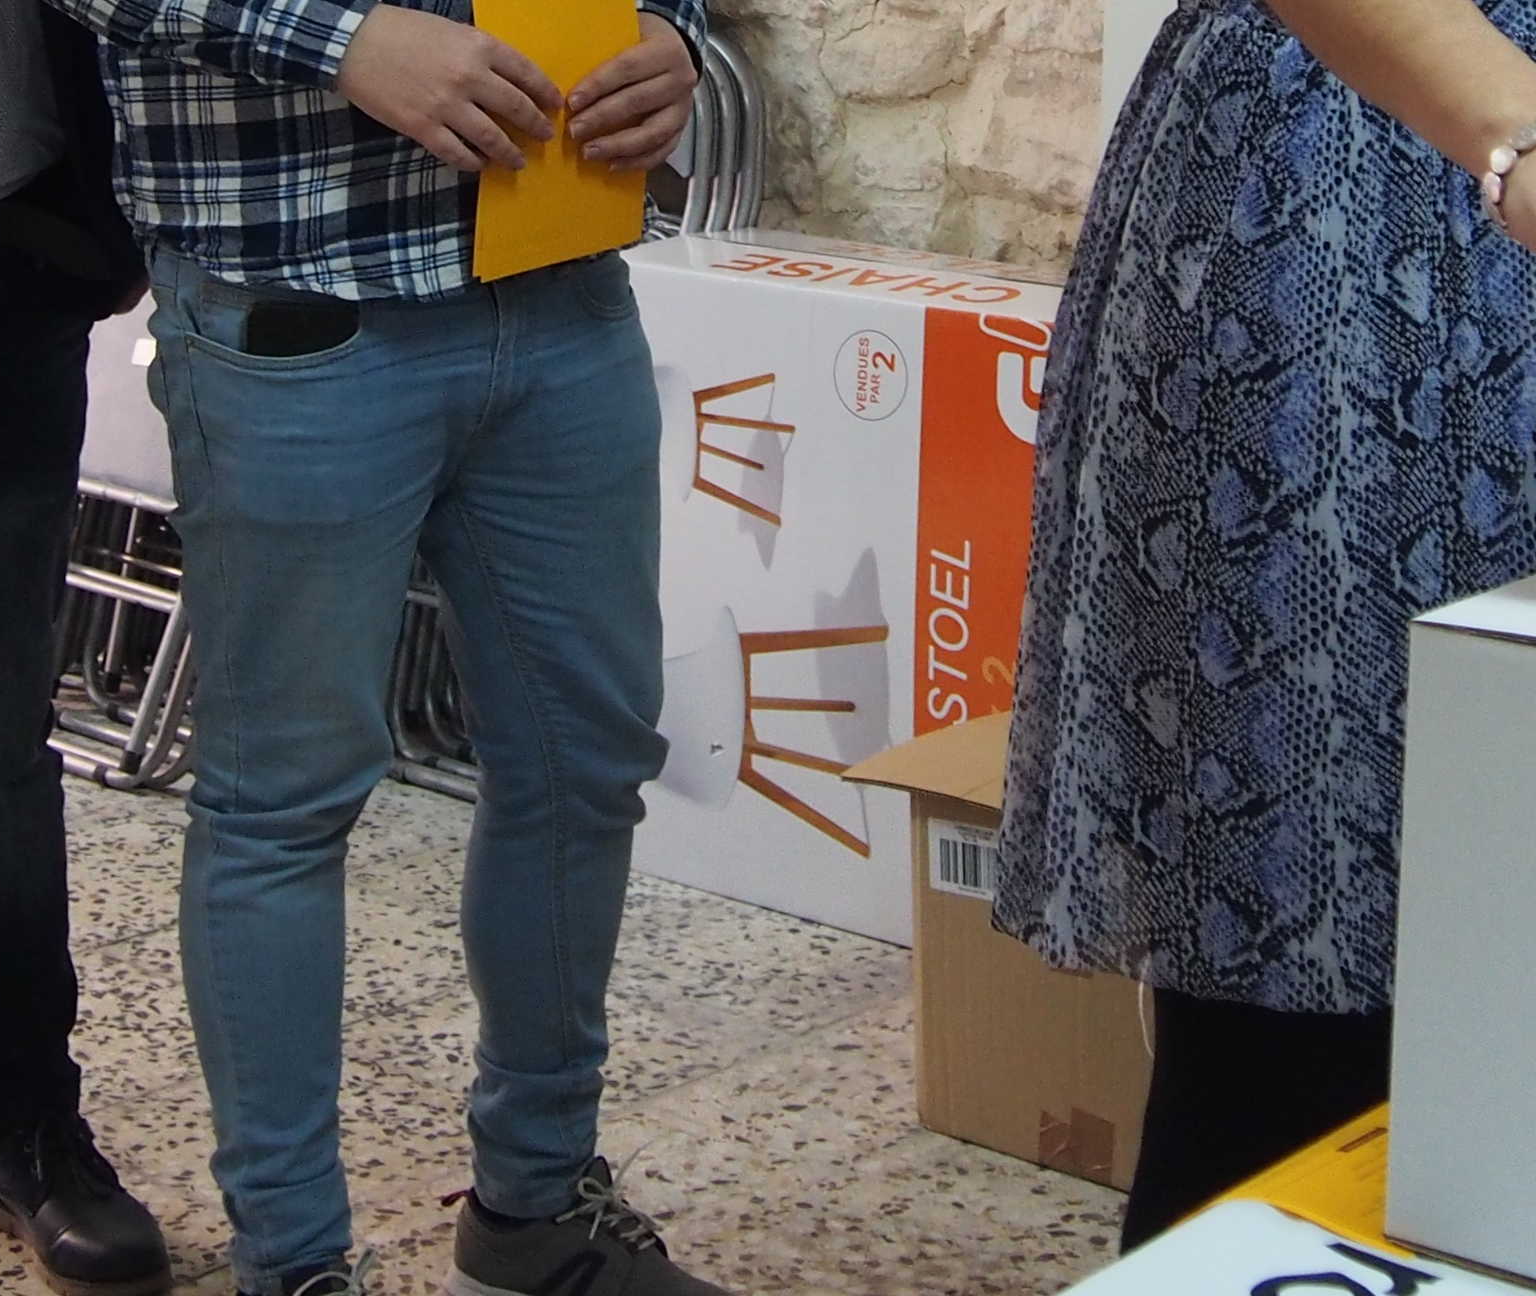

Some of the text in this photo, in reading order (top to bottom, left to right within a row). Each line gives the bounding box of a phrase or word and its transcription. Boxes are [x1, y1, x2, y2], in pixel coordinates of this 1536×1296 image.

[711, 253, 1022, 304] CHAISE
[855, 336, 870, 413] VENDUES
[869, 351, 897, 405] PAR 2
[927, 539, 971, 728] STOEL
